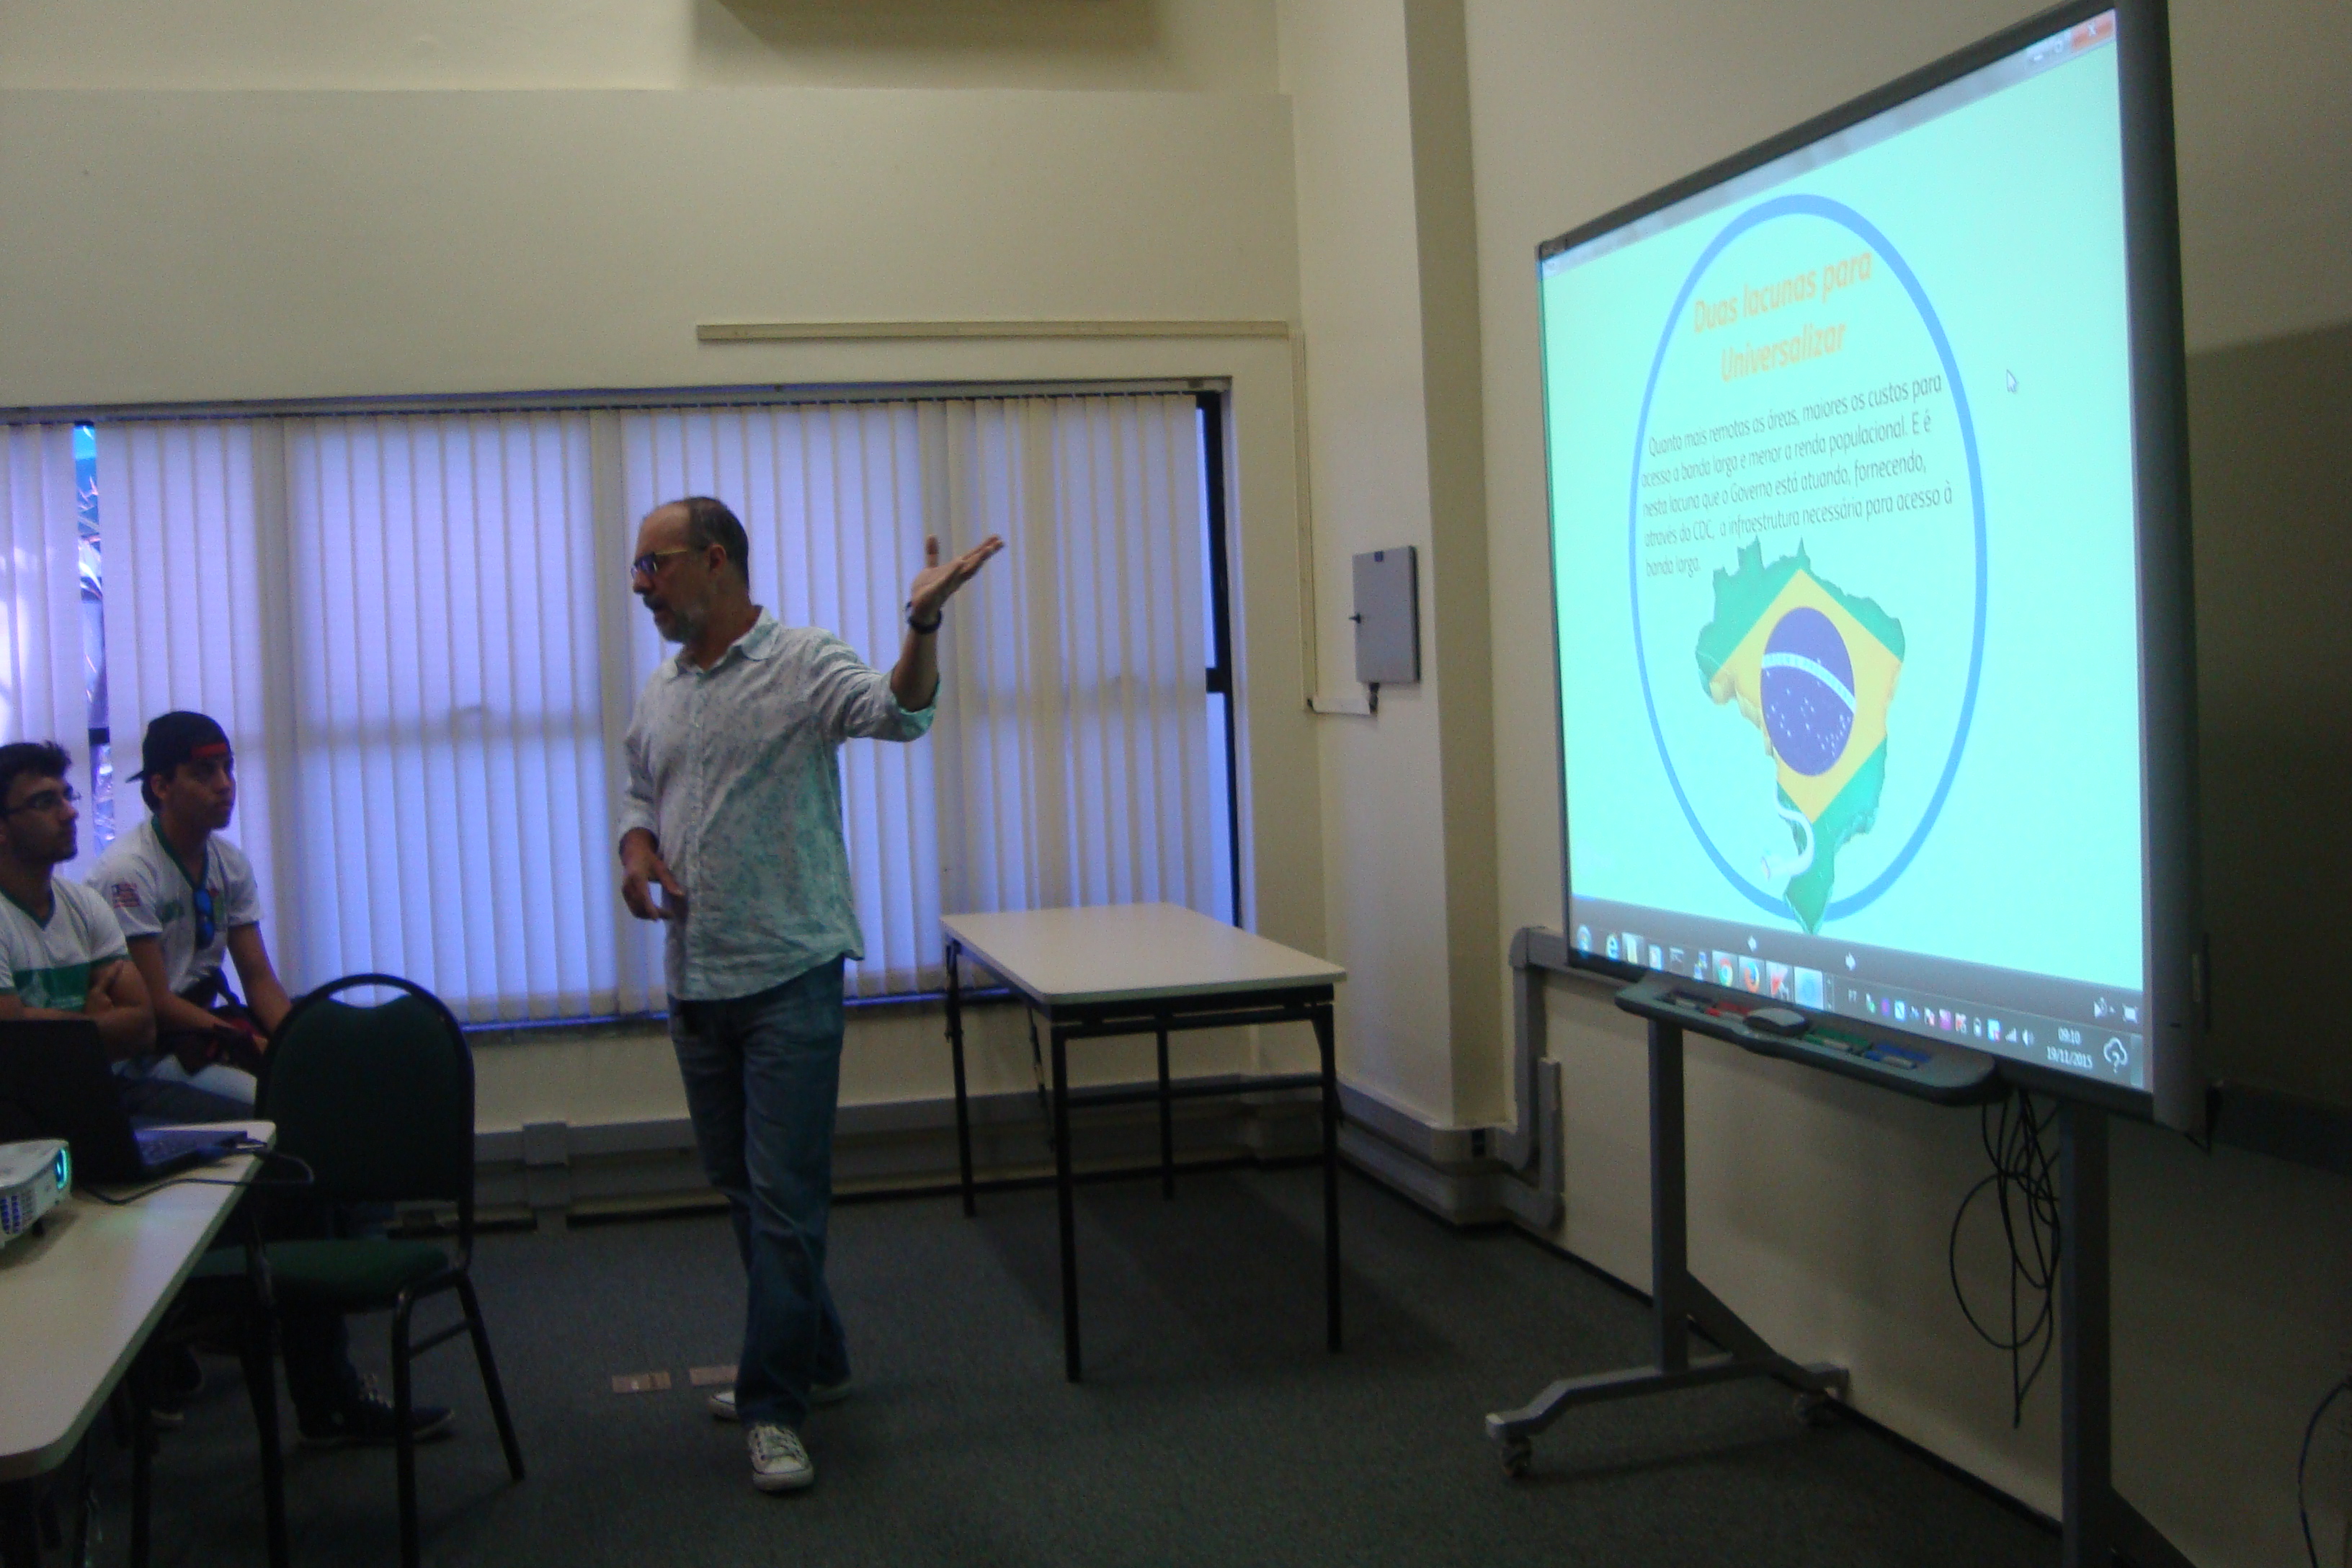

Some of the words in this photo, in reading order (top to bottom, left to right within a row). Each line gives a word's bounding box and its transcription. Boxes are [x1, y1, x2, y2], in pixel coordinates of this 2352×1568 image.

[1693, 296, 1738, 334] Duas
[1742, 269, 1817, 318] lacunas
[1822, 250, 1874, 304] para
[1720, 321, 1847, 383] Universalizar
[1642, 469, 1672, 488] acesso
[1680, 458, 1711, 480] banda
[1713, 453, 1738, 478] larga
[1740, 453, 1747, 468] e
[1748, 445, 1782, 467] menor
[1784, 444, 1792, 460] a
[1794, 432, 1826, 458] renda
[1829, 414, 1908, 458] populacional.
[1912, 411, 1920, 434] E
[1923, 408, 1932, 433] é
[1649, 434, 1683, 457] Quanto
[1684, 427, 1707, 448] mais
[1709, 419, 1750, 442] remotas
[1752, 416, 1765, 434] as
[1767, 409, 1800, 430] áreas,
[1802, 397, 1848, 422] maiores
[1850, 393, 1866, 411] os
[1868, 381, 1909, 408] custos
[1912, 374, 1942, 404] para
[1643, 497, 1667, 517] nesta
[1669, 491, 1700, 513] lacuna
[1701, 489, 1719, 512] que
[1721, 489, 1728, 504] o
[1730, 481, 1773, 503] Governo
[1775, 471, 1799, 495] está
[1801, 462, 1851, 491] atuando,
[1854, 448, 1927, 488] fornecendo,
[1644, 526, 1678, 548] através
[1719, 521, 1727, 538] a
[1728, 508, 1801, 539] infraestrutura
[1802, 496, 1863, 525] necessária
[1865, 495, 1894, 522] para
[1896, 488, 1941, 512] acesso
[1944, 479, 1953, 504] à
[1646, 556, 1674, 577] banda
